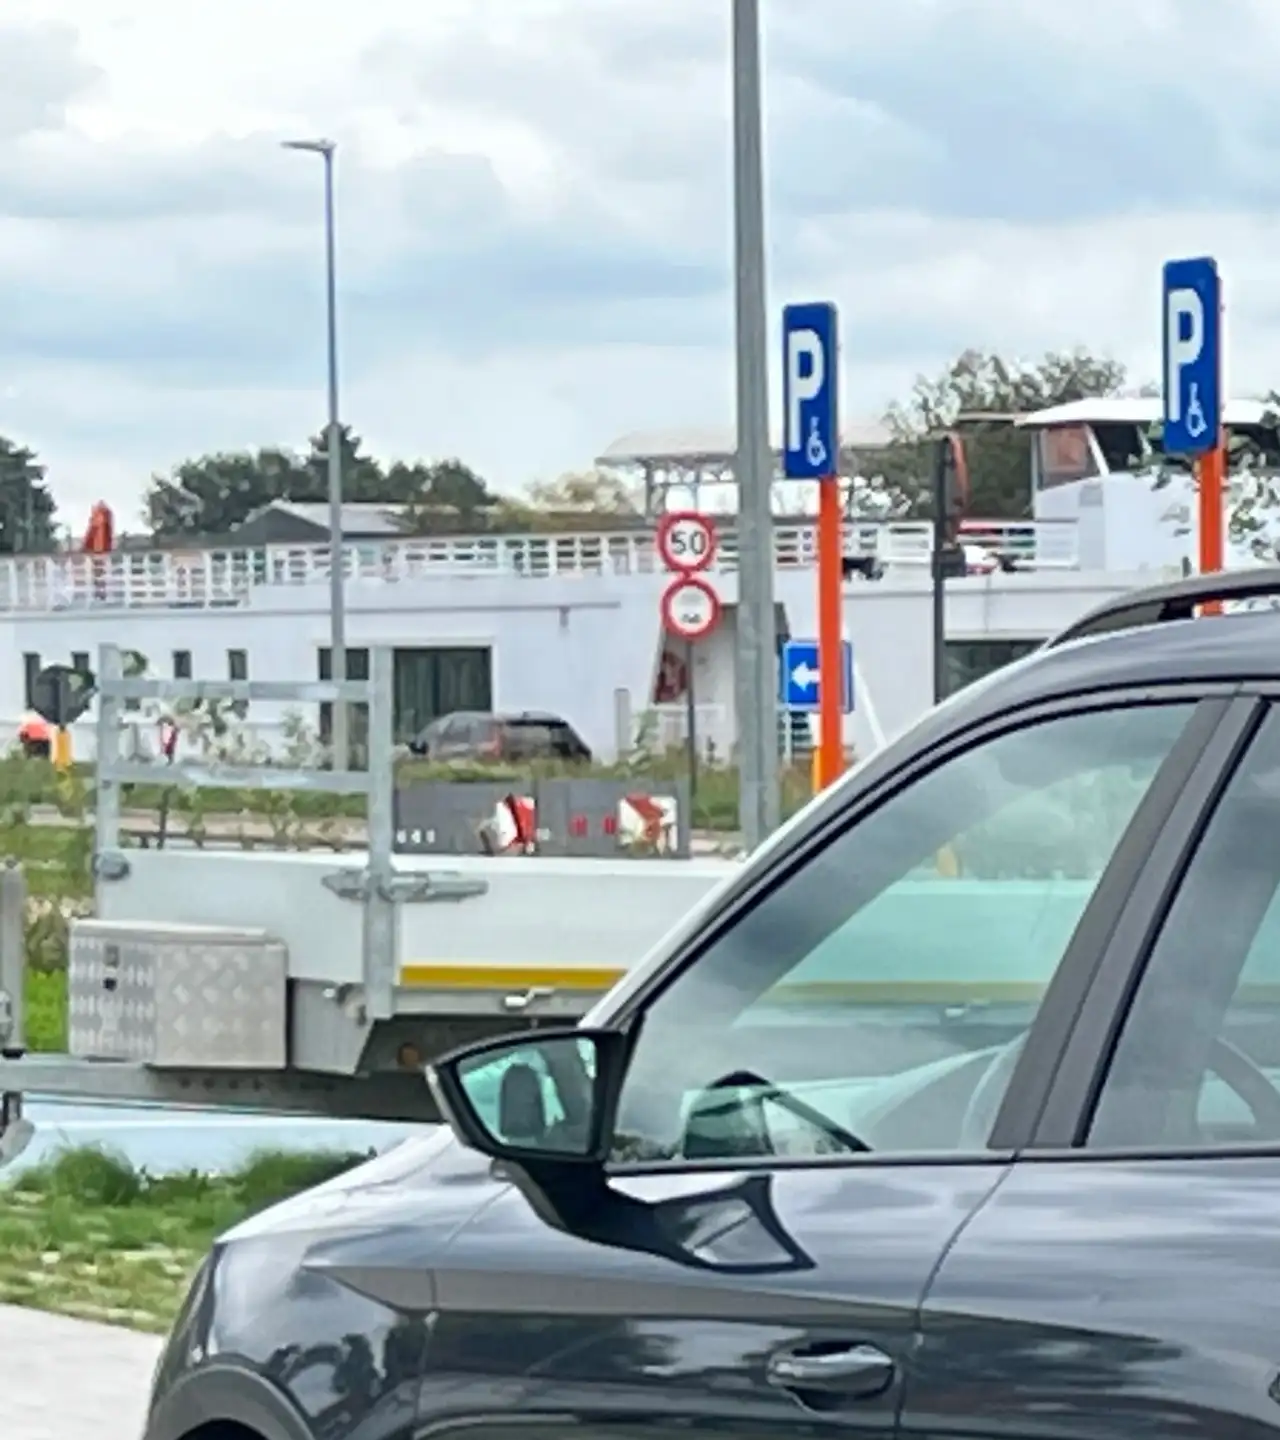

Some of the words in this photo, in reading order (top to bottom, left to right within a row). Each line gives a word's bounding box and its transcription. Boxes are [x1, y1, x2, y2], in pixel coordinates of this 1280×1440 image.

[788, 328, 824, 452] P
[1168, 288, 1204, 423] P
[670, 530, 706, 555] 50
